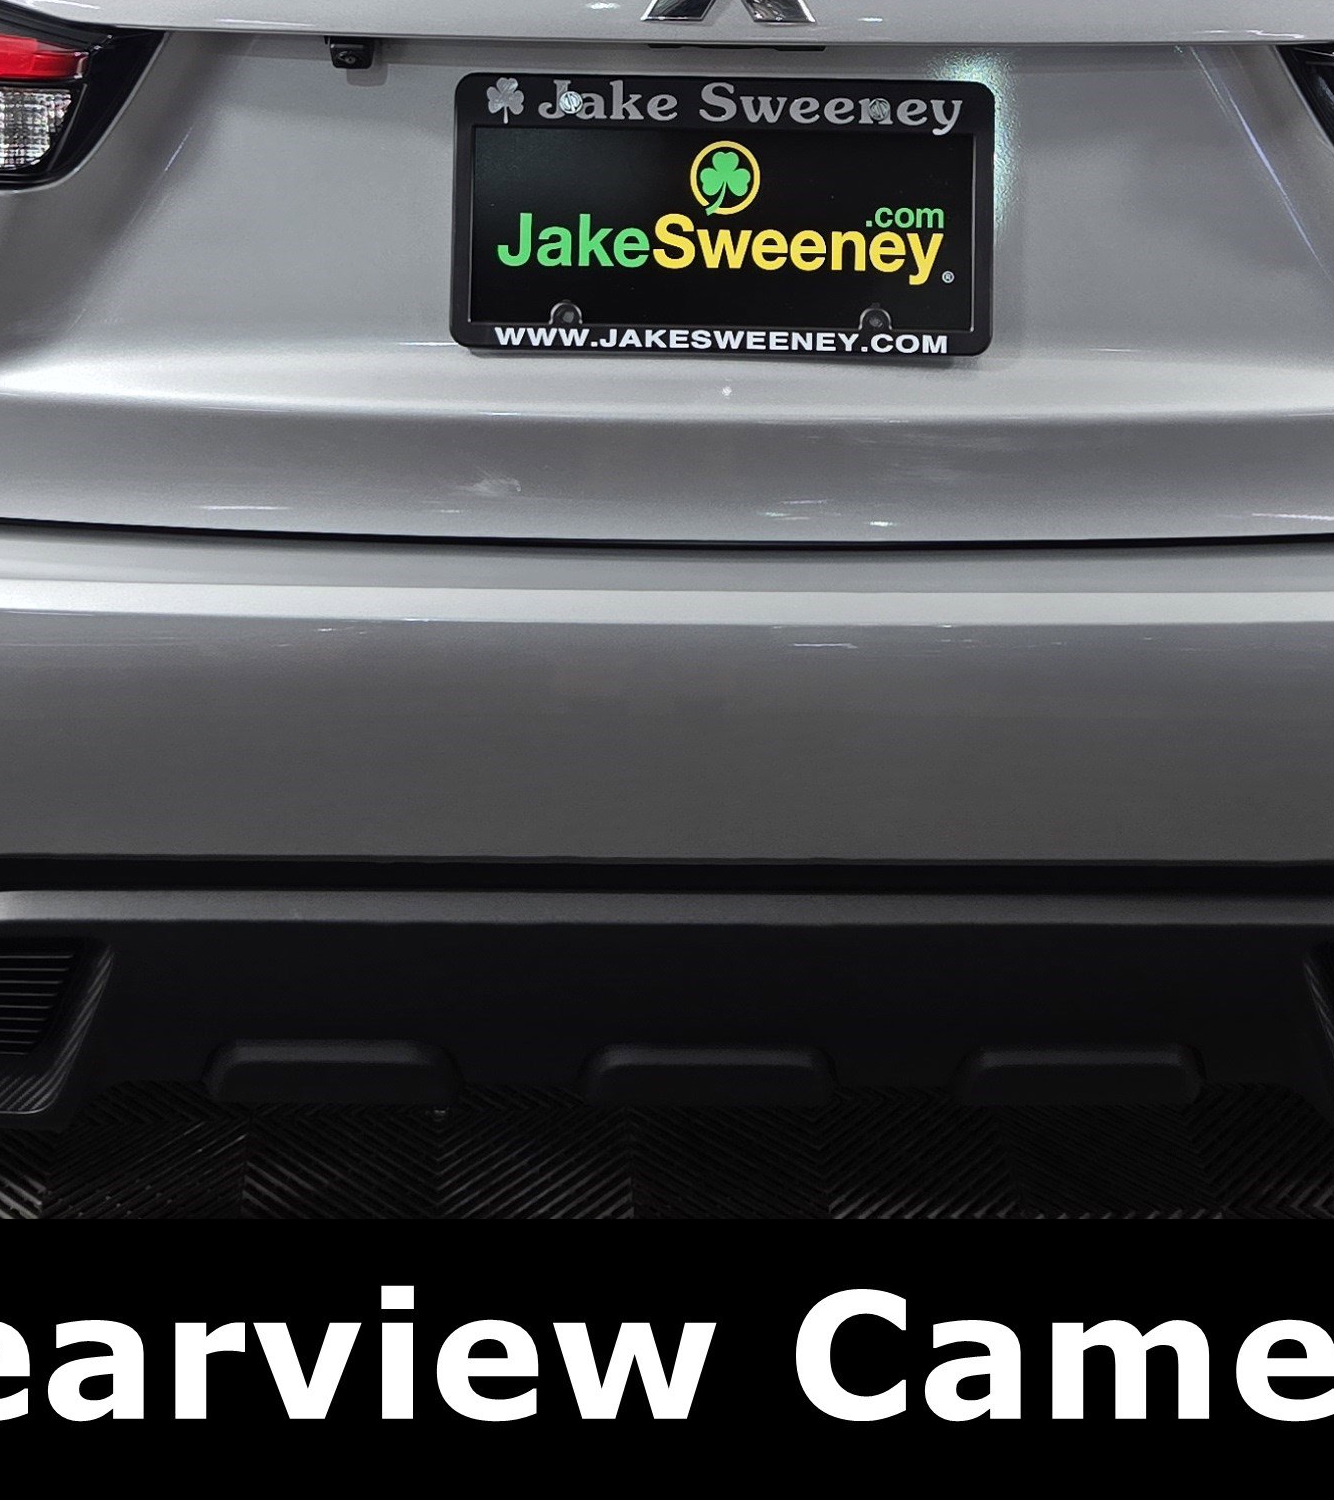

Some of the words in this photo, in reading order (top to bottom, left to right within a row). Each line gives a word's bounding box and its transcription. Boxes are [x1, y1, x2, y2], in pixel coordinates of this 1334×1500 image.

[537, 78, 678, 124] Jake
[698, 82, 963, 135] Sweeney
[494, 327, 948, 354] WWW.JAKESWEENEY.COM
